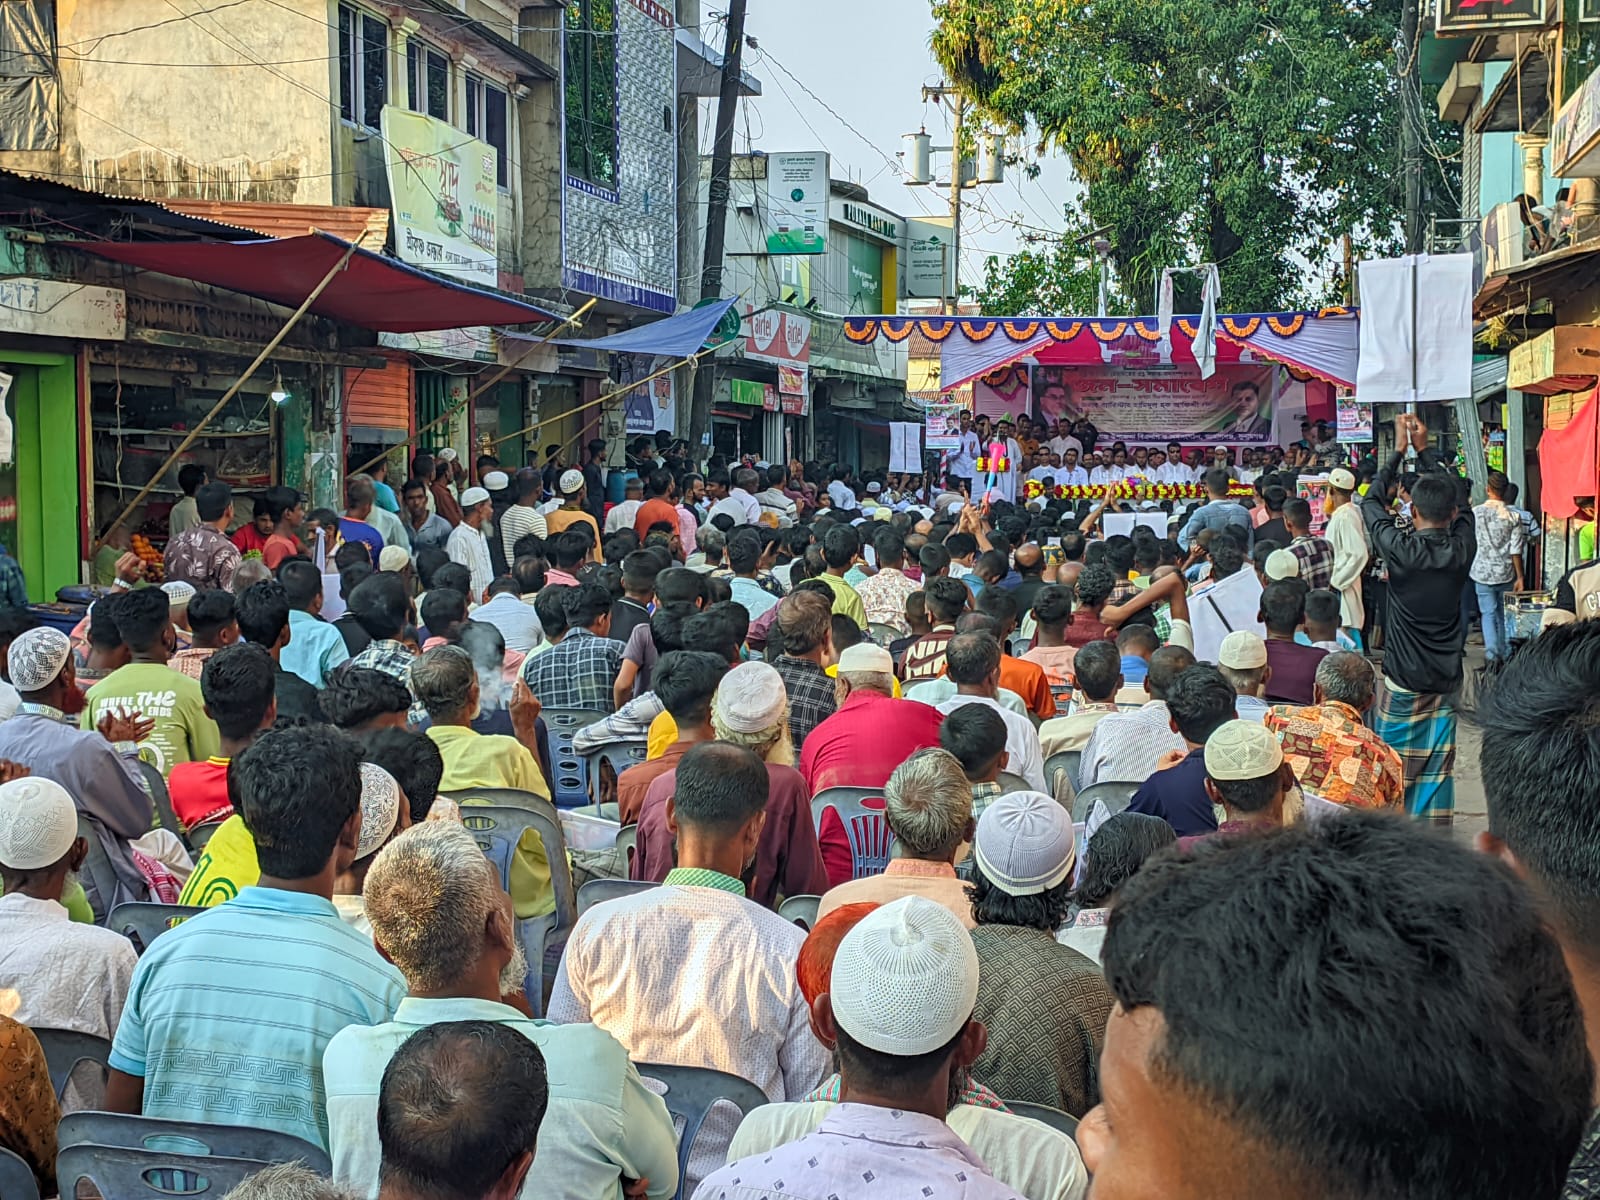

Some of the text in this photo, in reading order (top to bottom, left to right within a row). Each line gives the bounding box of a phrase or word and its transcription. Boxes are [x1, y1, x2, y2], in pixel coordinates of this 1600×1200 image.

[754, 313, 772, 337] airtel
[787, 320, 803, 344] airtel
[906, 640, 949, 680] NIK
[100, 690, 177, 708] WHERE THE
[147, 706, 172, 717] ENDS
